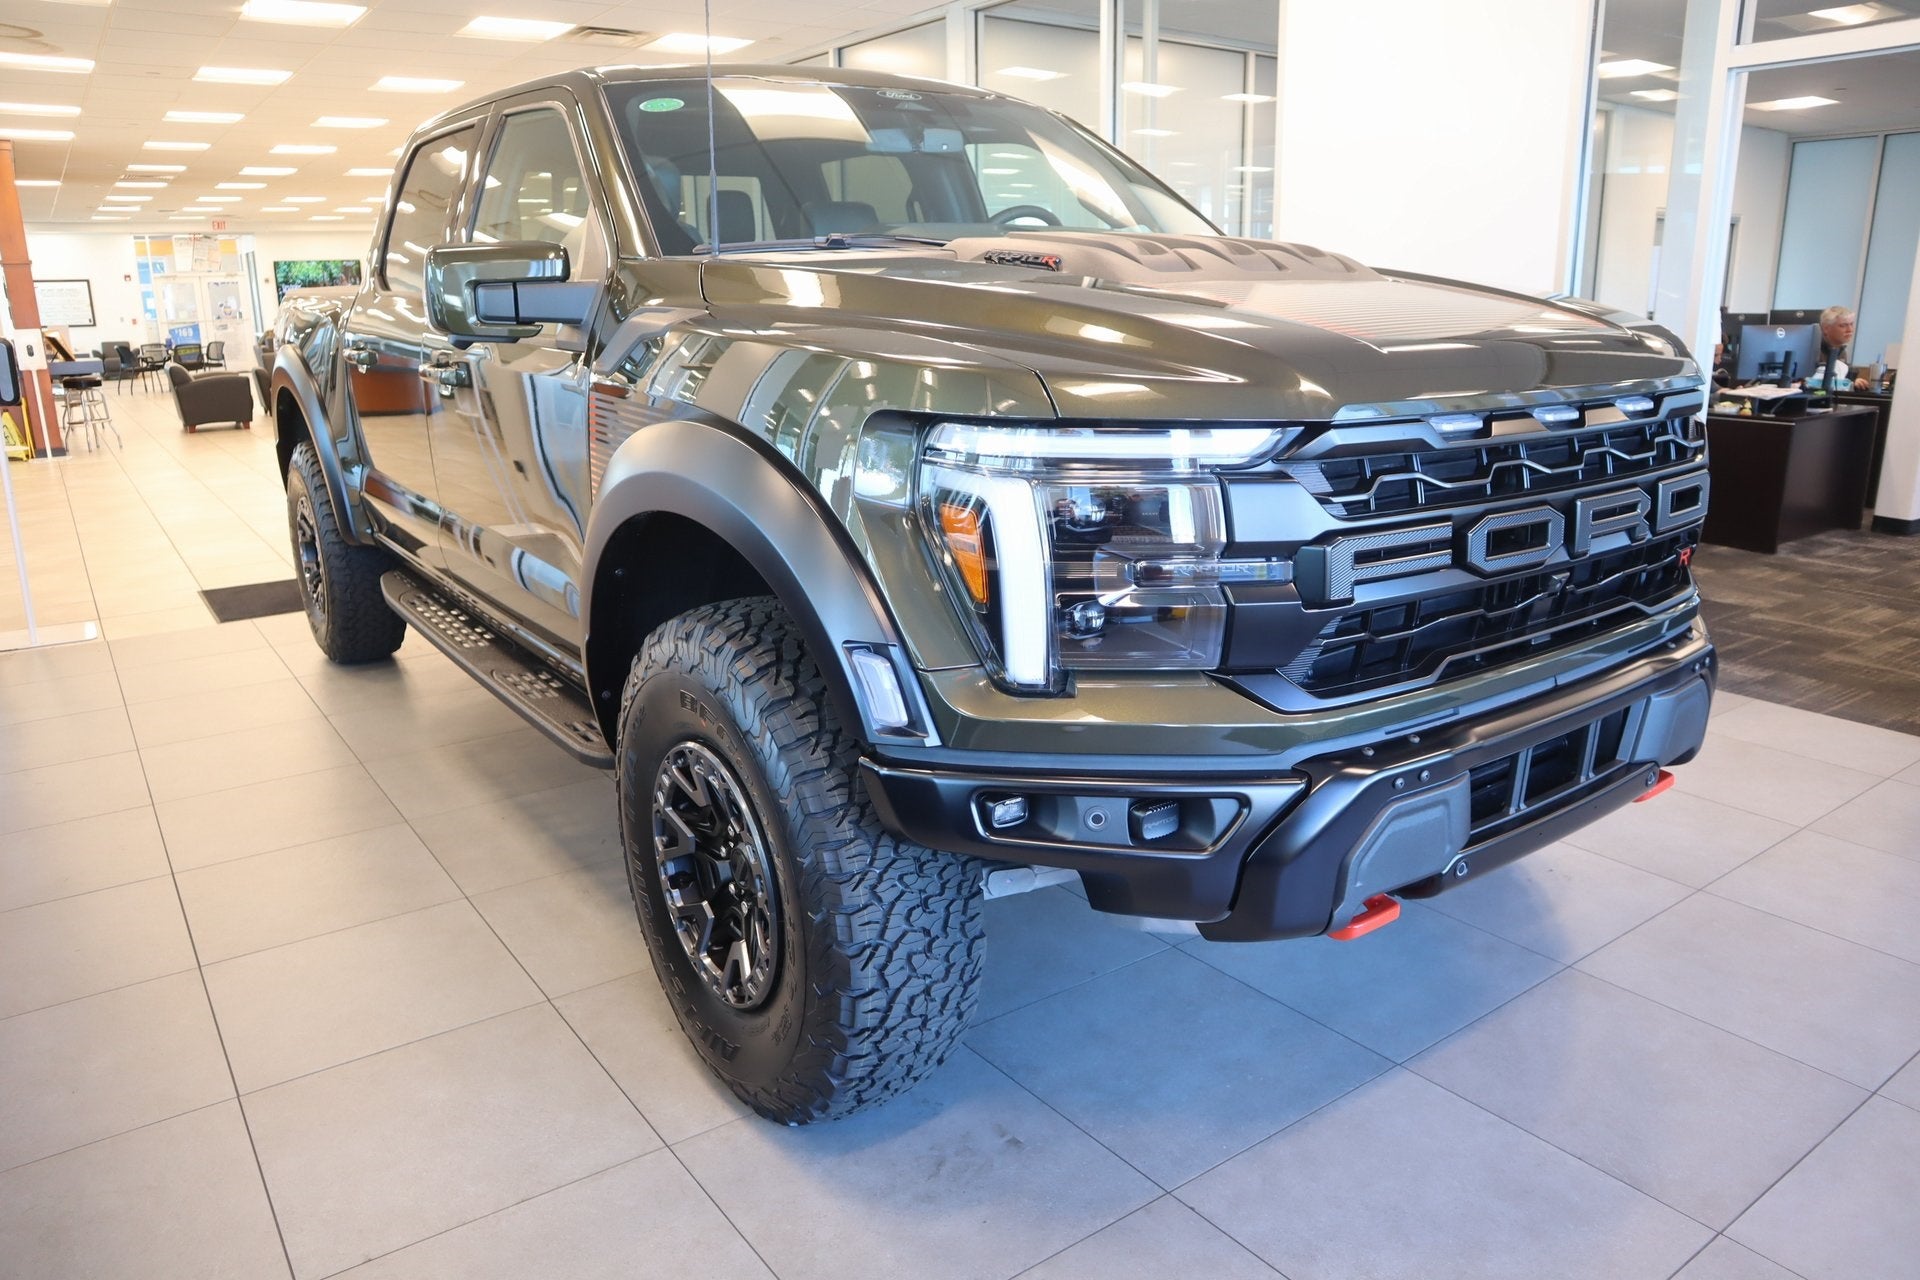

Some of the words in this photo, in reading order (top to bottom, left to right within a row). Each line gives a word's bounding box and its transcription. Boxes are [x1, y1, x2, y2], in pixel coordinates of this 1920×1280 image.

[212, 220, 226, 230] EXIT
[984, 250, 1059, 271] RAPTOR
[1329, 468, 1710, 600] FORD
[1680, 547, 1691, 567] R
[1173, 563, 1251, 577] RAPTOR
